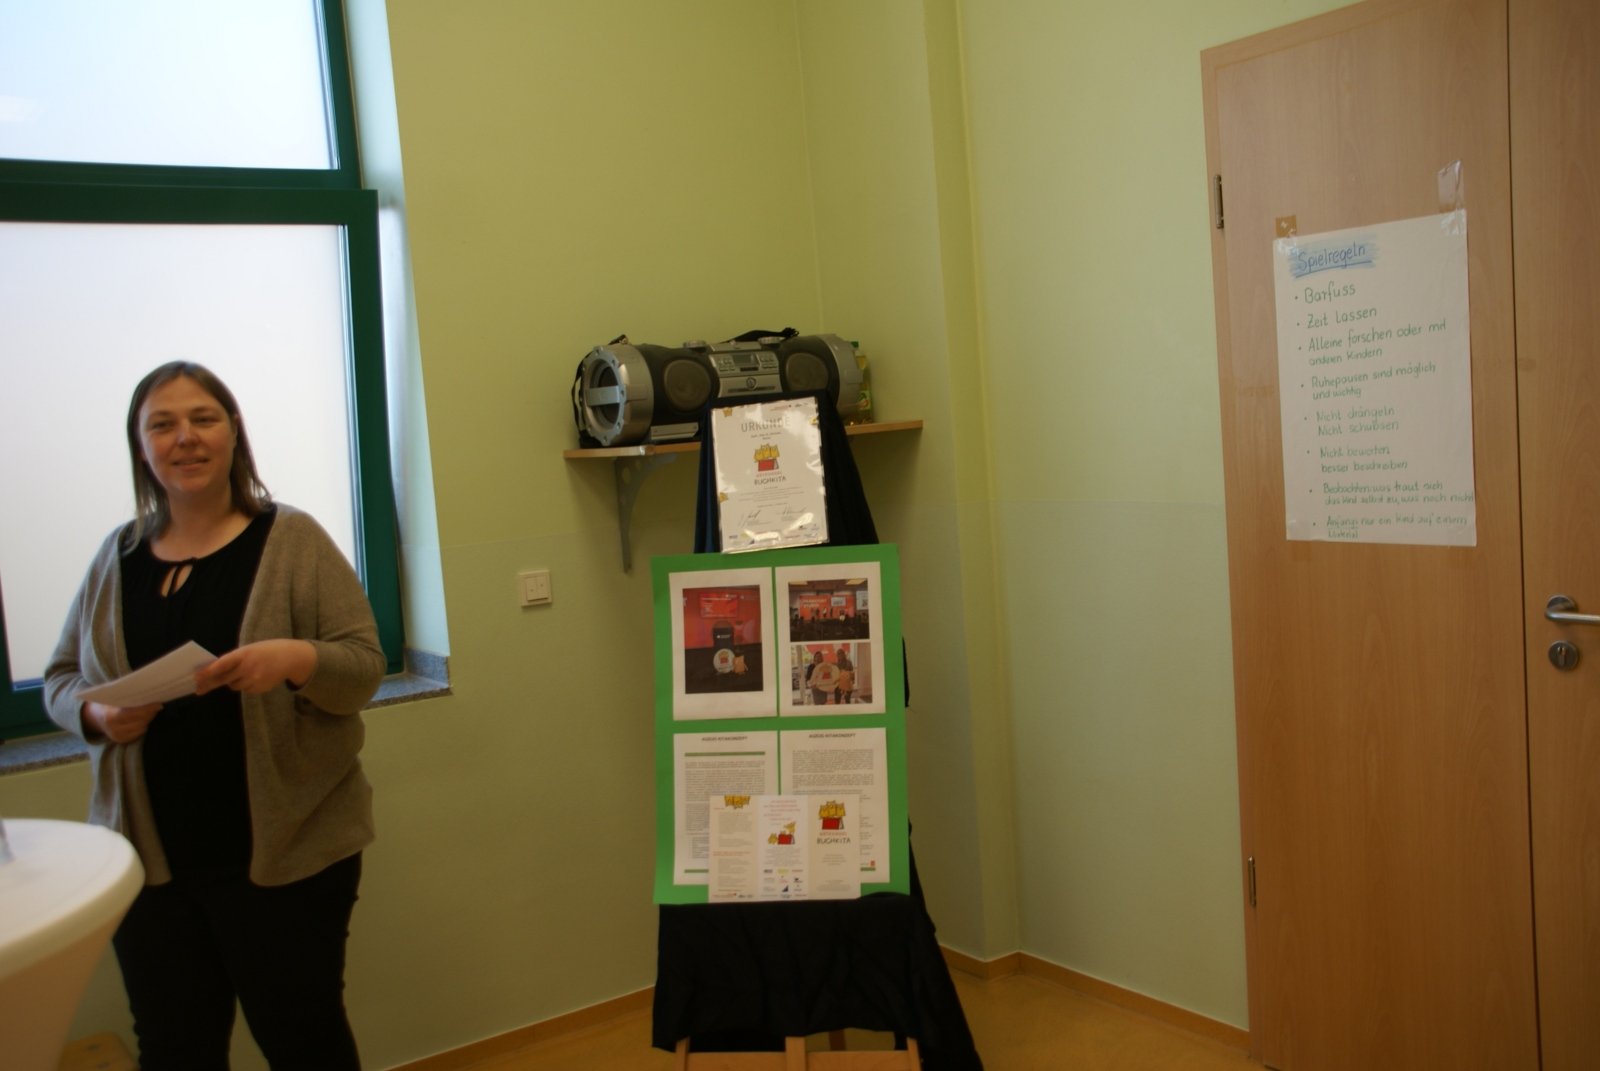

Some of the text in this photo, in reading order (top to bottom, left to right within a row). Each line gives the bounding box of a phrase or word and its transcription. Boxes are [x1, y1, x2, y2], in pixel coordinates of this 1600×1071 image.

[1297, 240, 1366, 273] Spielregeln
[1304, 280, 1356, 304] Barfuss
[1307, 312, 1328, 329] Zeit
[1308, 319, 1447, 352] Alleine forschen oder mit
[1309, 354, 1342, 367] anderen
[1311, 361, 1436, 389] Ruhepausen sind möglich
[1312, 386, 1362, 401] und wichtig
[1316, 405, 1395, 424] Nicht drängeln
[741, 416, 791, 433] URKUNDE
[1318, 420, 1399, 437] Nicht schubsen
[1320, 446, 1343, 459] Nicht
[1394, 480, 1419, 492] traut
[1423, 480, 1443, 490] sich
[1423, 493, 1446, 503] noch
